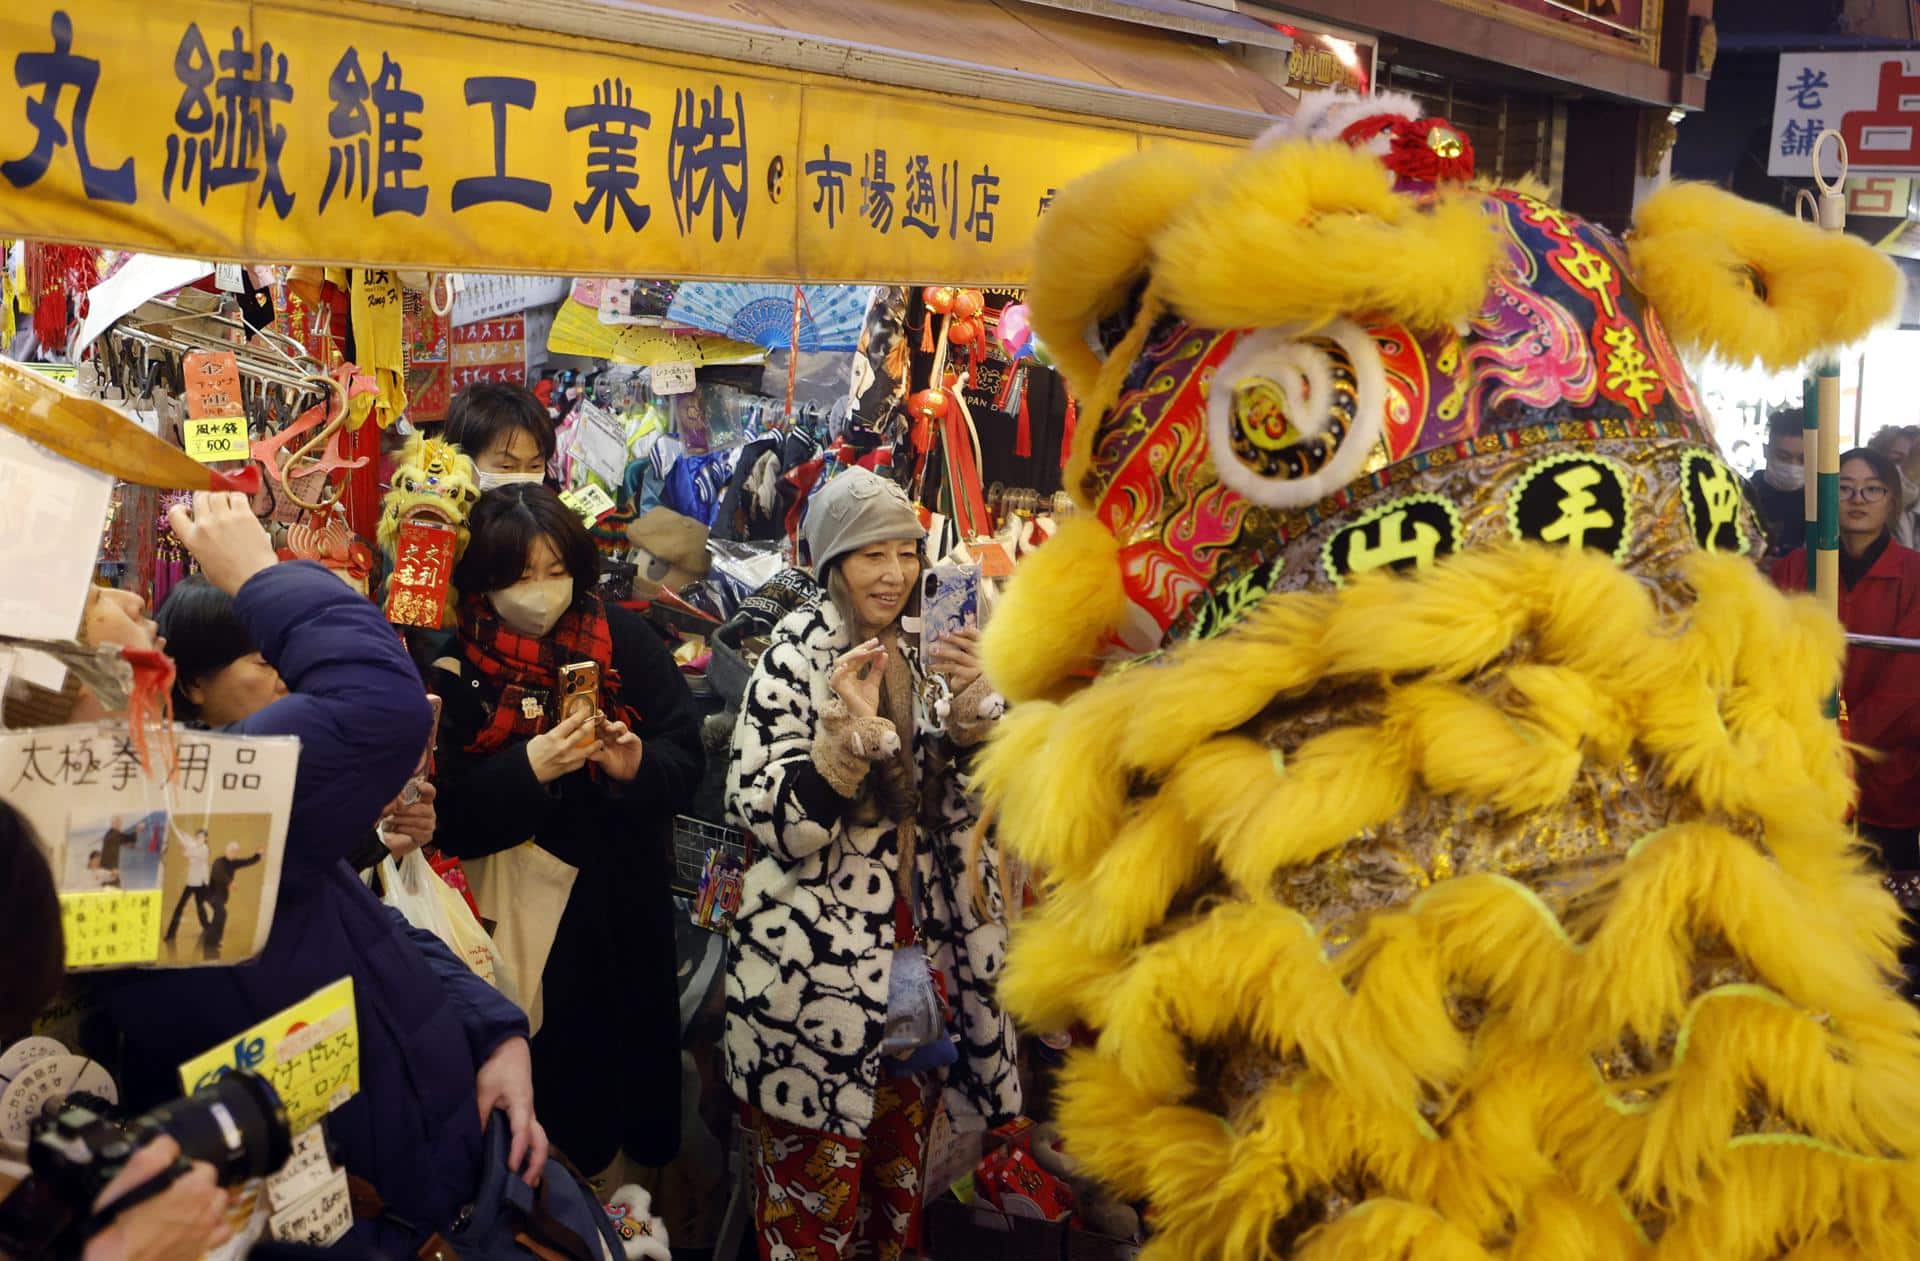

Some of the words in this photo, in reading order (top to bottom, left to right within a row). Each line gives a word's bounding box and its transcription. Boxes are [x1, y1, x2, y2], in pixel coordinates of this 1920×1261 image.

[805, 144, 1000, 243] 市場通り店
[11, 736, 263, 793] 太極拳用品
